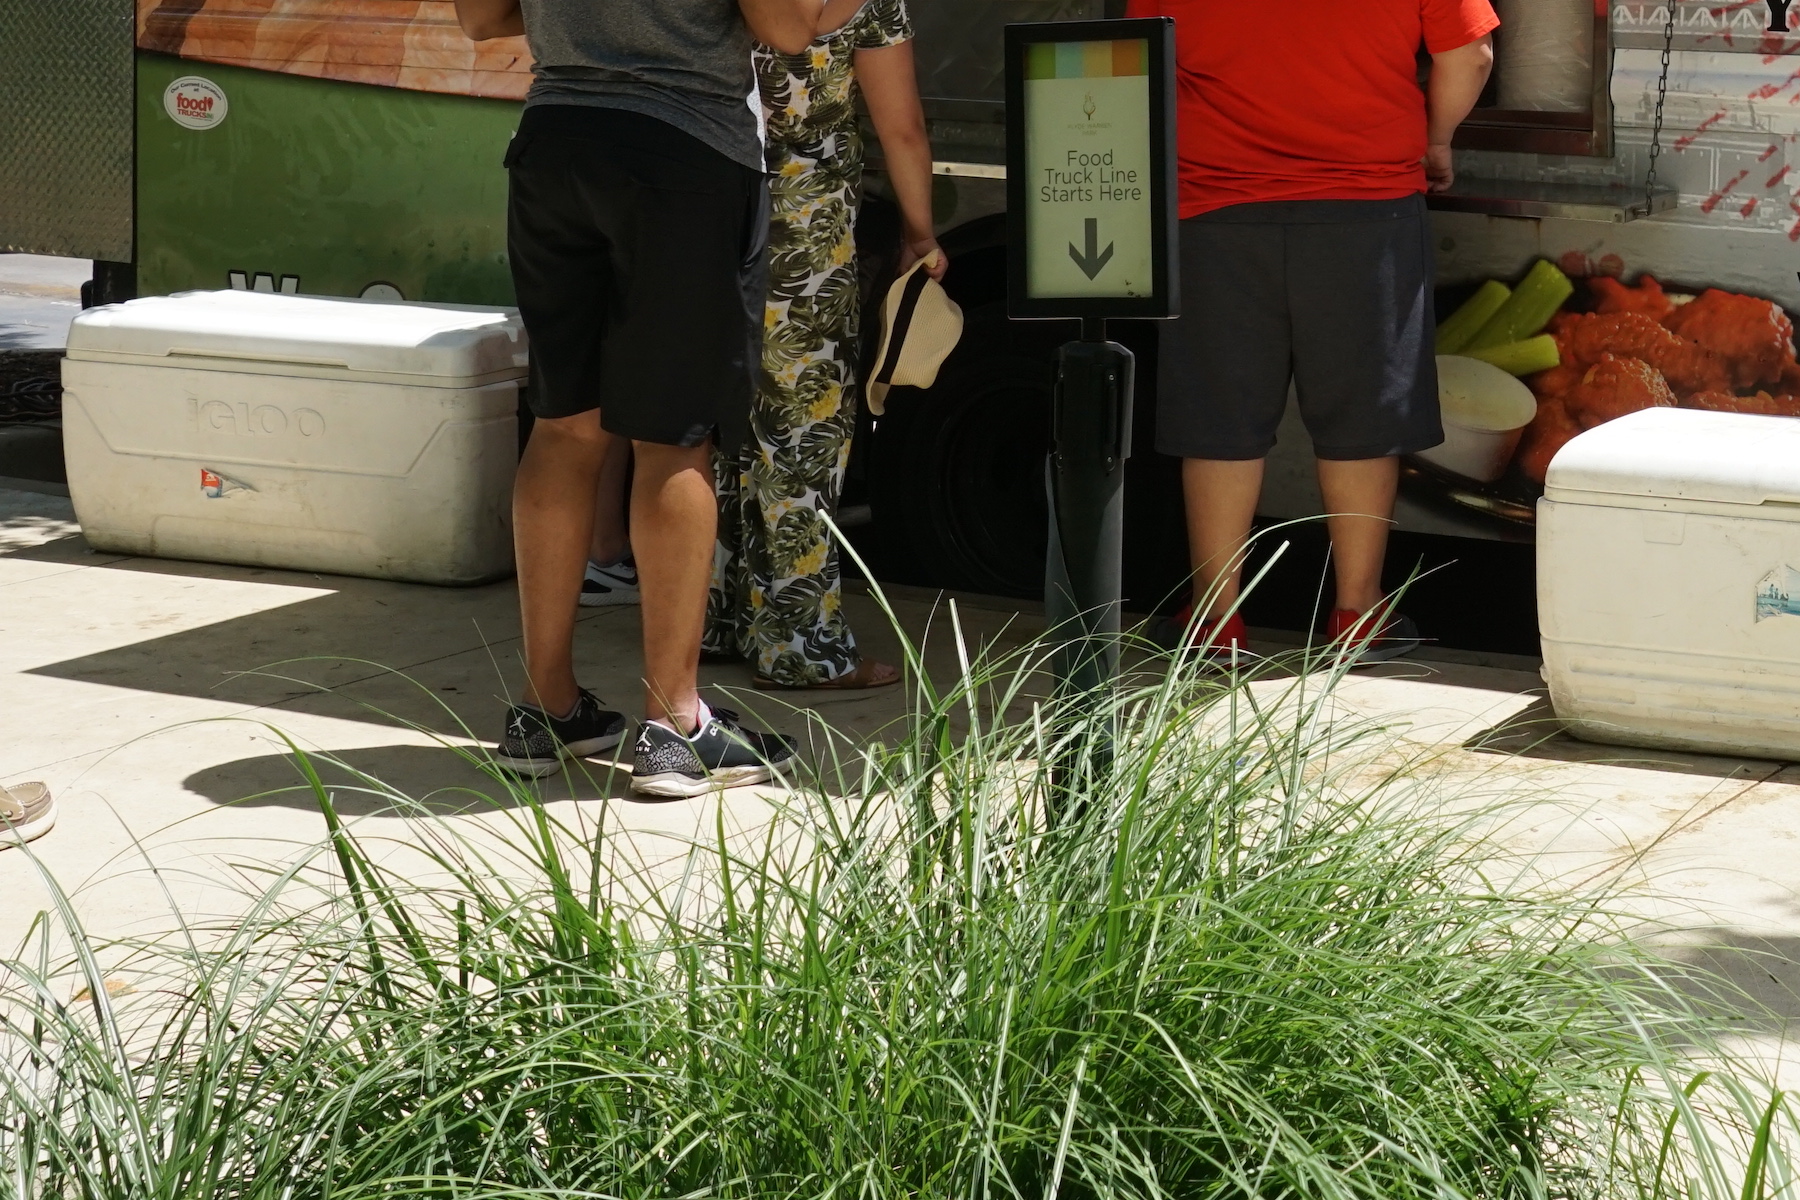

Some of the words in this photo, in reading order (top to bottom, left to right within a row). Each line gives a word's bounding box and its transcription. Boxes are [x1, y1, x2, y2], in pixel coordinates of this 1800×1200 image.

[200, 83, 222, 101] Location
[176, 92, 207, 112] food
[1067, 148, 1114, 167] Food
[1044, 167, 1093, 185] Truck
[1100, 166, 1137, 184] Line
[1041, 185, 1093, 202] Starts
[1099, 184, 1142, 201] Here
